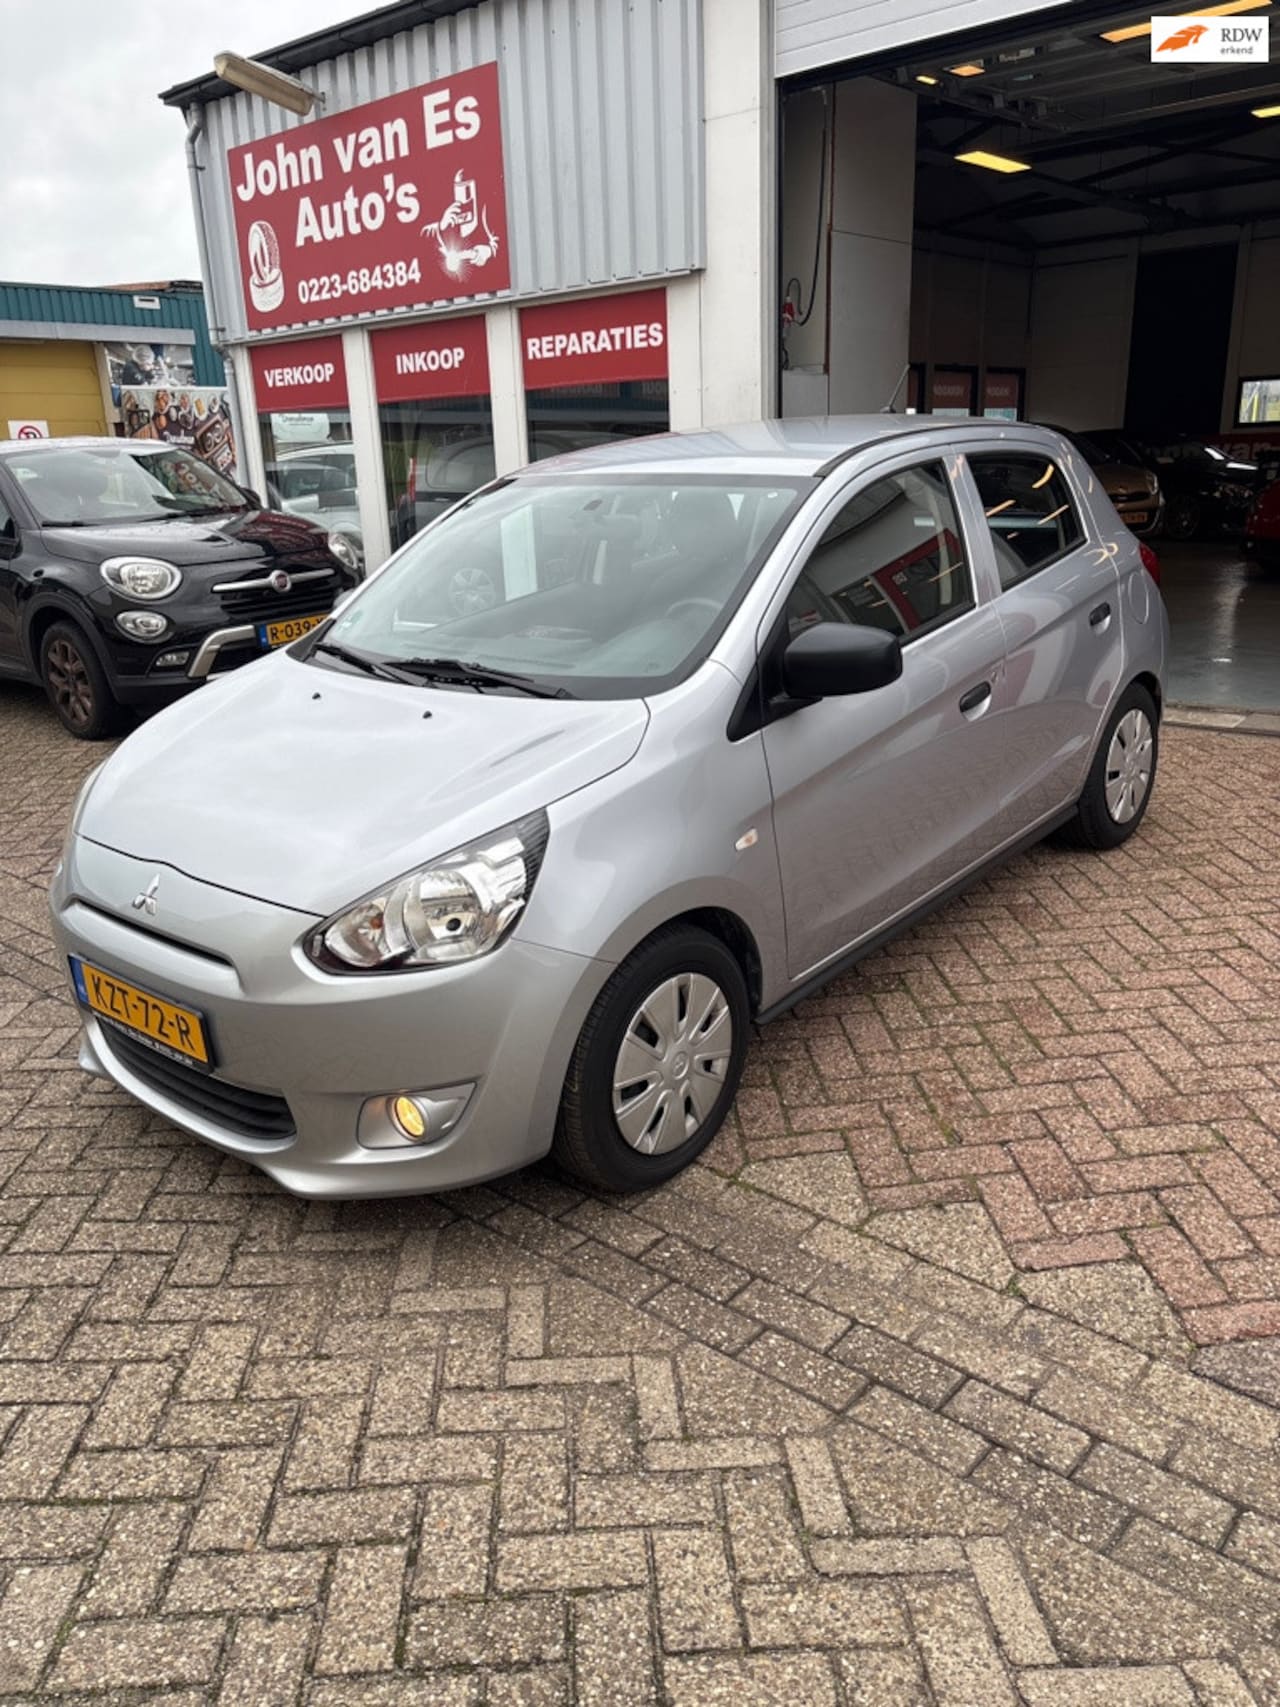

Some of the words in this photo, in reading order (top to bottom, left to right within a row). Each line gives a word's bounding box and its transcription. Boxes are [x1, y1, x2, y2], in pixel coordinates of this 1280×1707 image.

[236, 142, 323, 202] John
[333, 117, 410, 173] van
[422, 88, 481, 150] Es
[295, 172, 420, 247] Auto's
[298, 258, 422, 304] 0223-684384
[396, 347, 466, 374] INKOOP
[527, 322, 664, 360] REPARATIES
[264, 362, 335, 388] VERKOOP
[91, 973, 196, 1050] KZT-72-R
